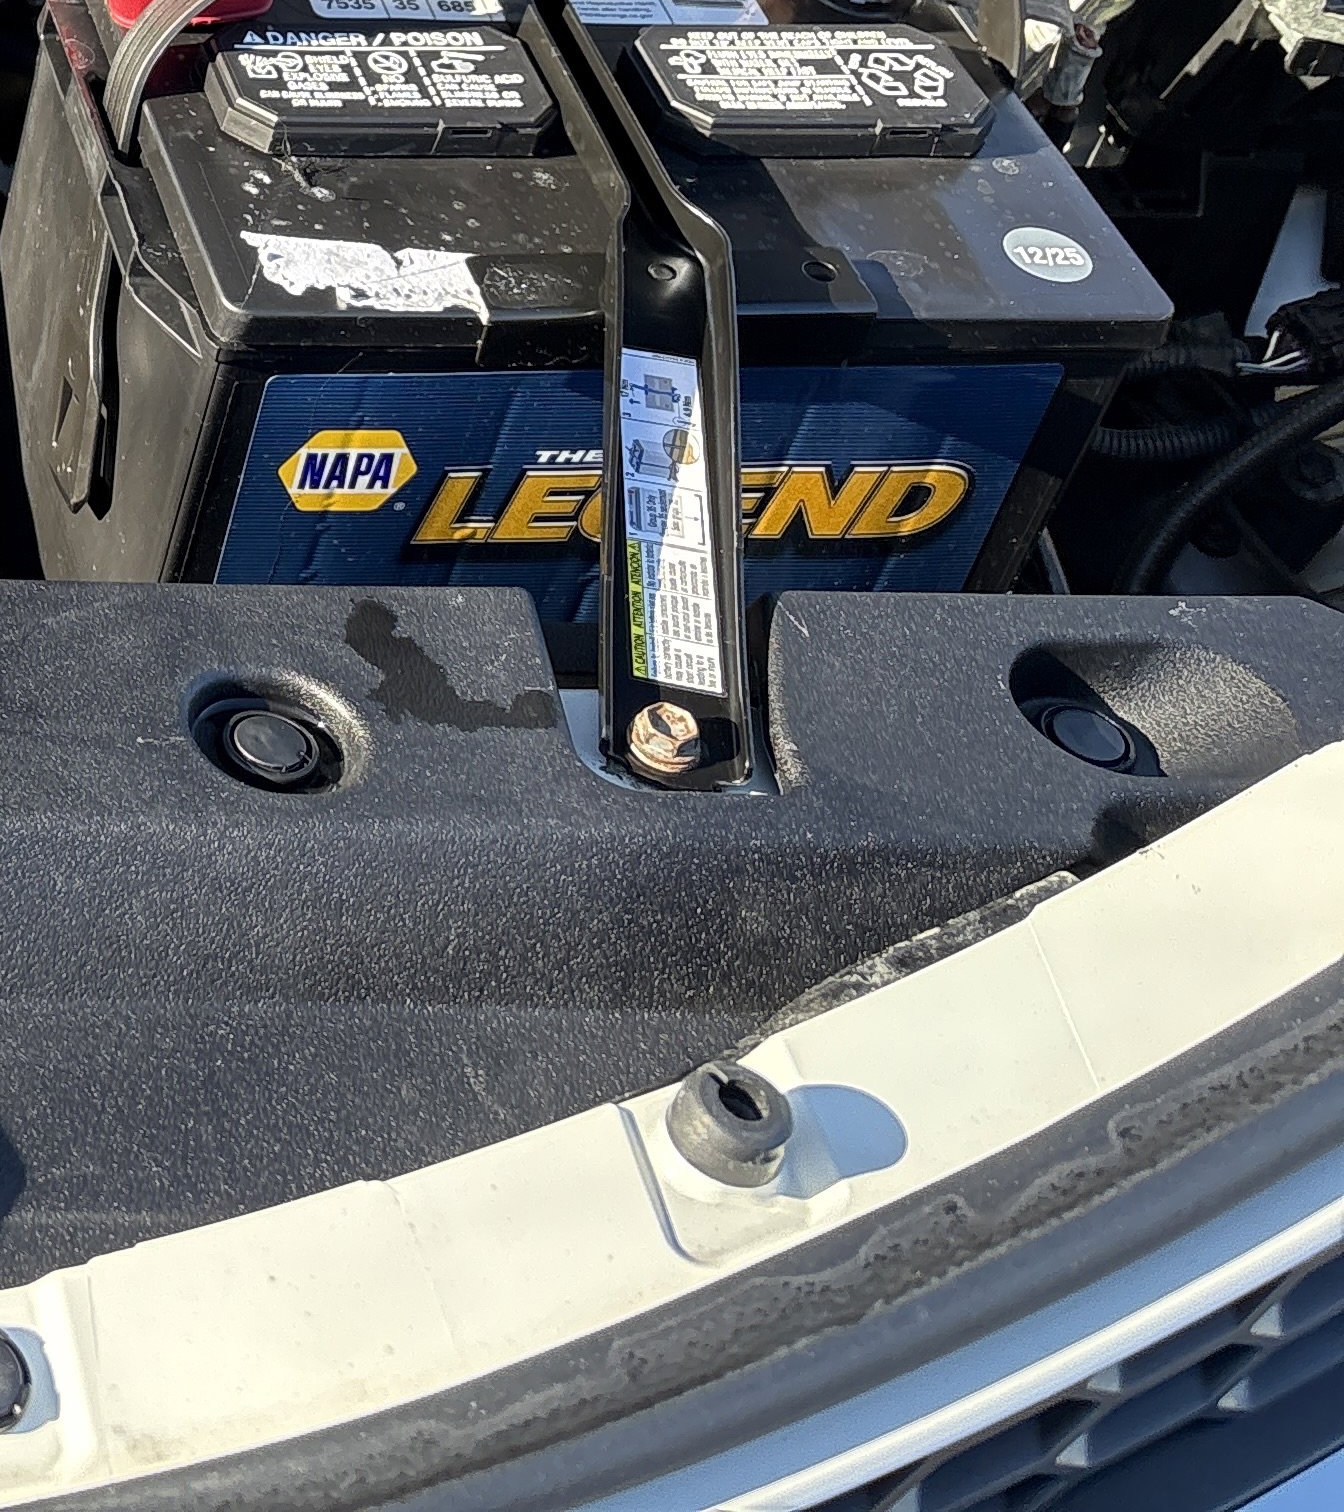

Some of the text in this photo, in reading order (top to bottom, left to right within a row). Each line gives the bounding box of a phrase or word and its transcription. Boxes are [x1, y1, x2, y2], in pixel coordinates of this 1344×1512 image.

[437, 0, 477, 13] 685
[265, 31, 484, 47] DANGER / POISON
[304, 54, 350, 64] SHIELD
[308, 64, 343, 73] EYES
[282, 72, 351, 82] EXPLOSIVE
[380, 73, 406, 83] NO
[431, 73, 525, 84] SULFURIC ACID
[1013, 246, 1085, 267] 12/25
[534, 449, 603, 463] THE
[296, 452, 397, 490] NAPA
[631, 590, 645, 629] ATTENTION
[633, 633, 646, 666] CAUTION
